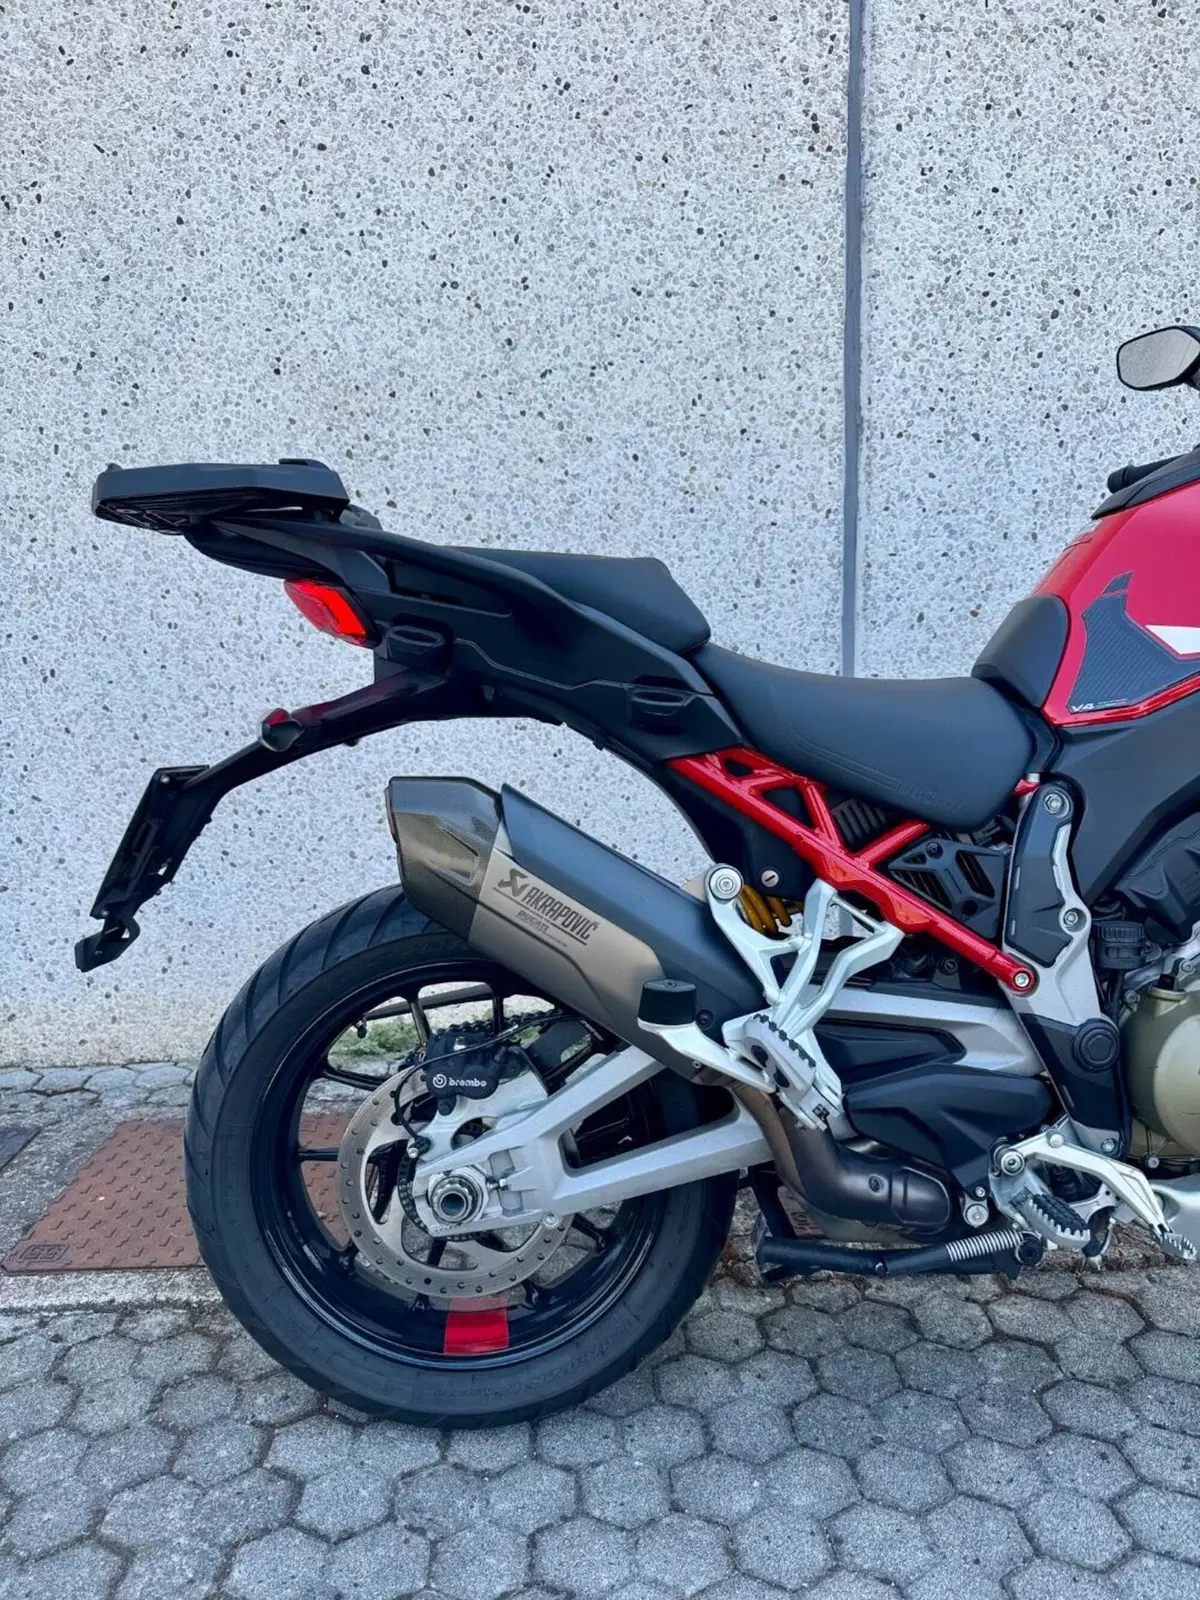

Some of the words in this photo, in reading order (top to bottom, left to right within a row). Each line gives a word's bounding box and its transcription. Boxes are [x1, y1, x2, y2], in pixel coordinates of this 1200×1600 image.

[1072, 703, 1095, 712] V4
[521, 887, 599, 940] AKRAPOVIČ
[448, 1078, 487, 1087] brembo
